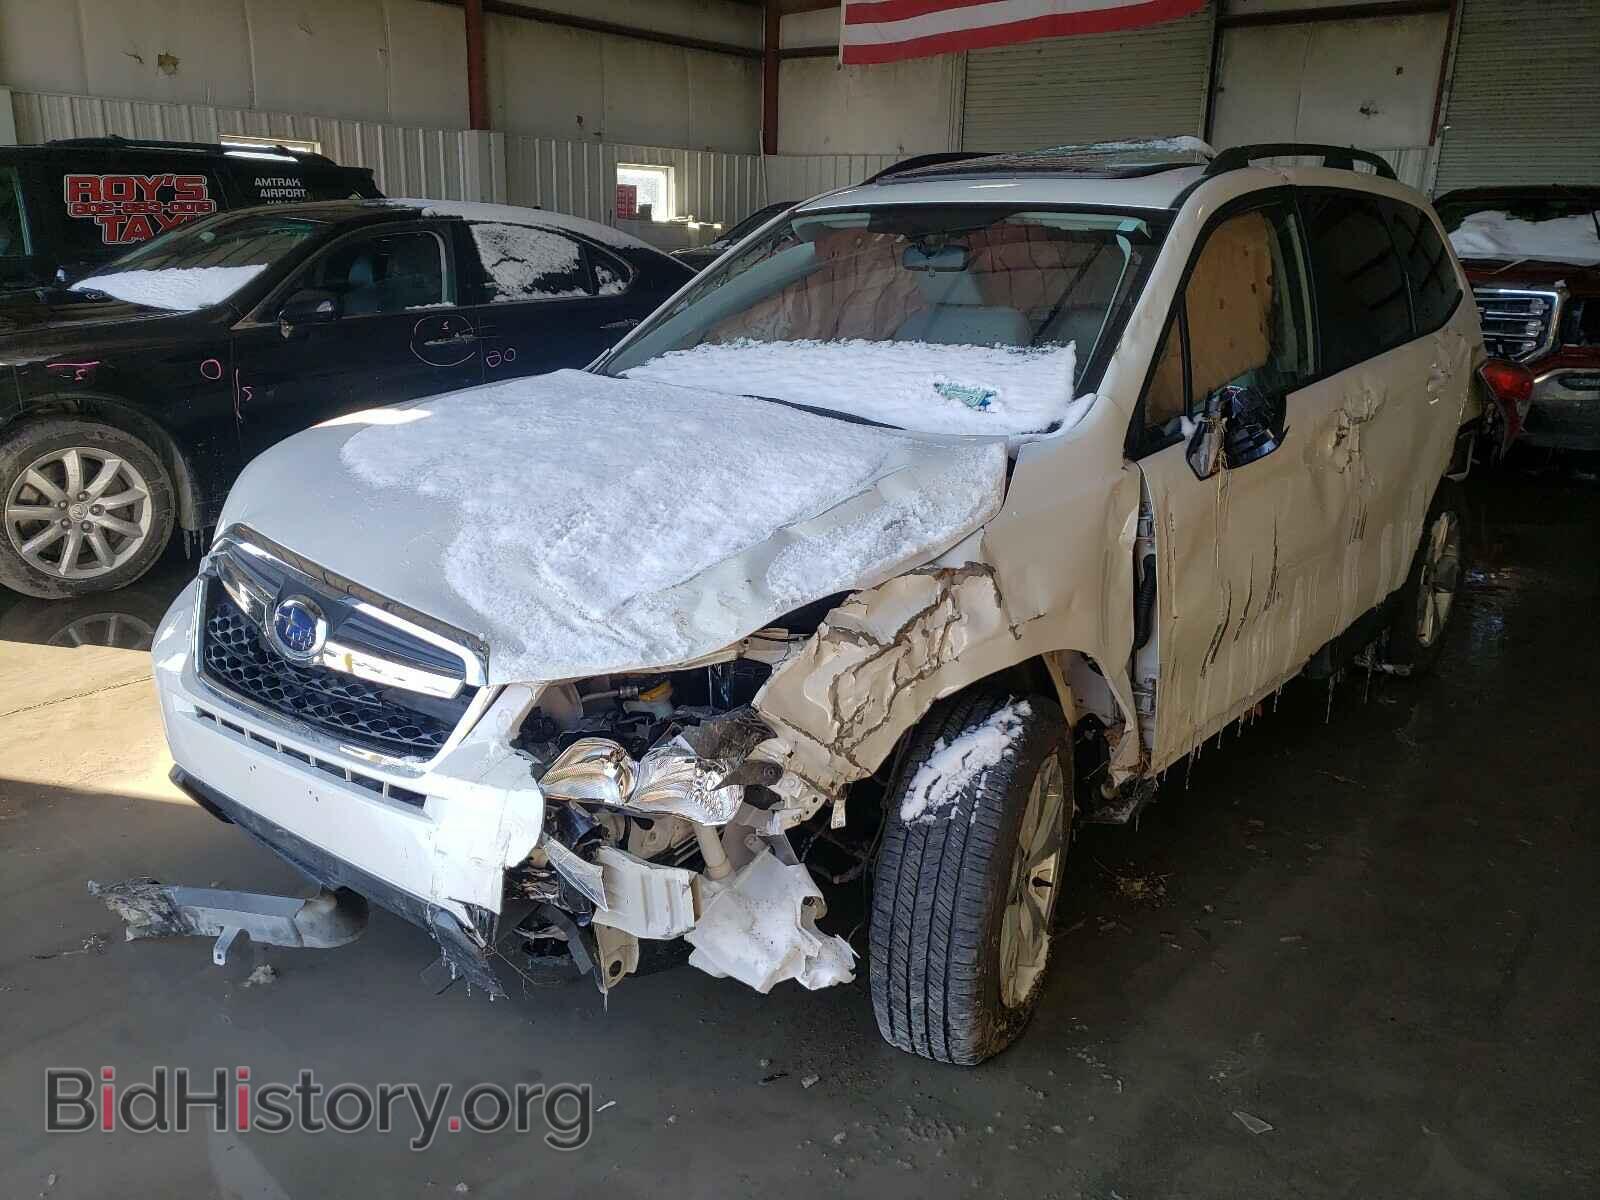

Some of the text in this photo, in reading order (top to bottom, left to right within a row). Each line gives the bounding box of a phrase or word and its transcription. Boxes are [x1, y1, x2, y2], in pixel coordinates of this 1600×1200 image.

[64, 174, 207, 202] ROY'S
[254, 177, 301, 187] AMTRAK
[260, 188, 306, 198] AIRPORT
[94, 212, 193, 244] TAX
